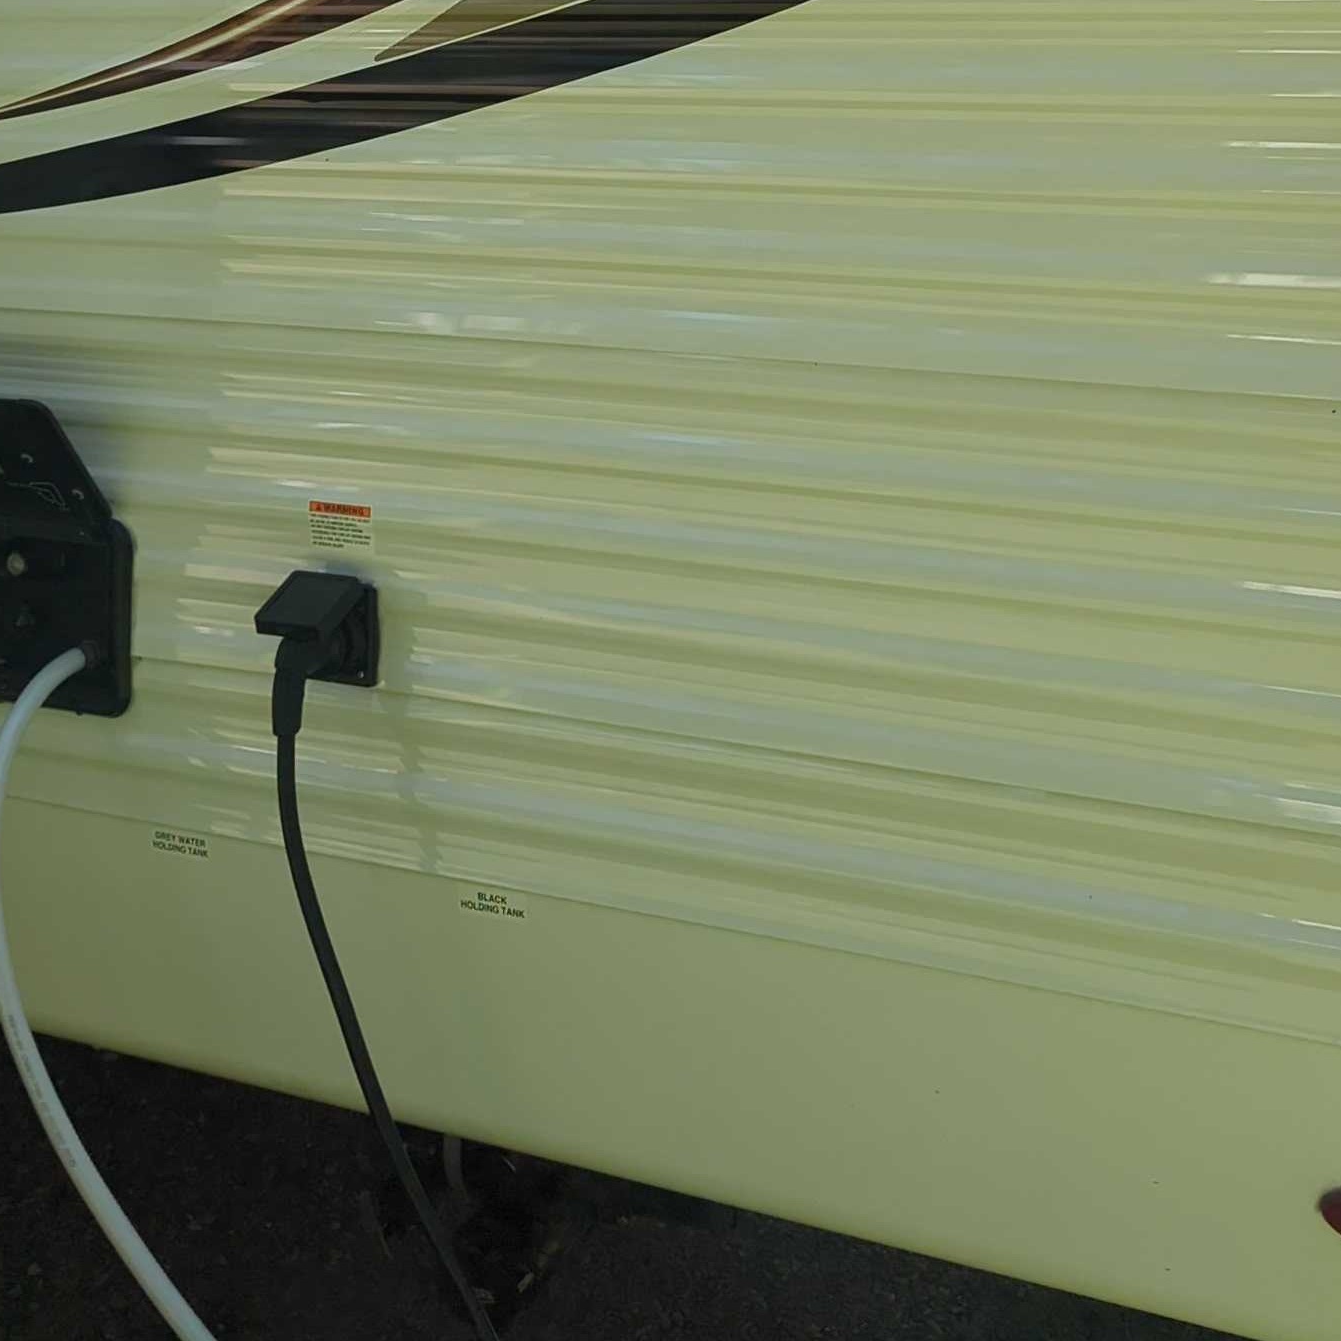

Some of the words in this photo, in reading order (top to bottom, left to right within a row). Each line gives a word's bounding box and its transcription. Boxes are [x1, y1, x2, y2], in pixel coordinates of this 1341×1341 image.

[477, 892, 507, 905] BLACK
[460, 900, 499, 914] HOLDING
[501, 906, 525, 918] TANK
